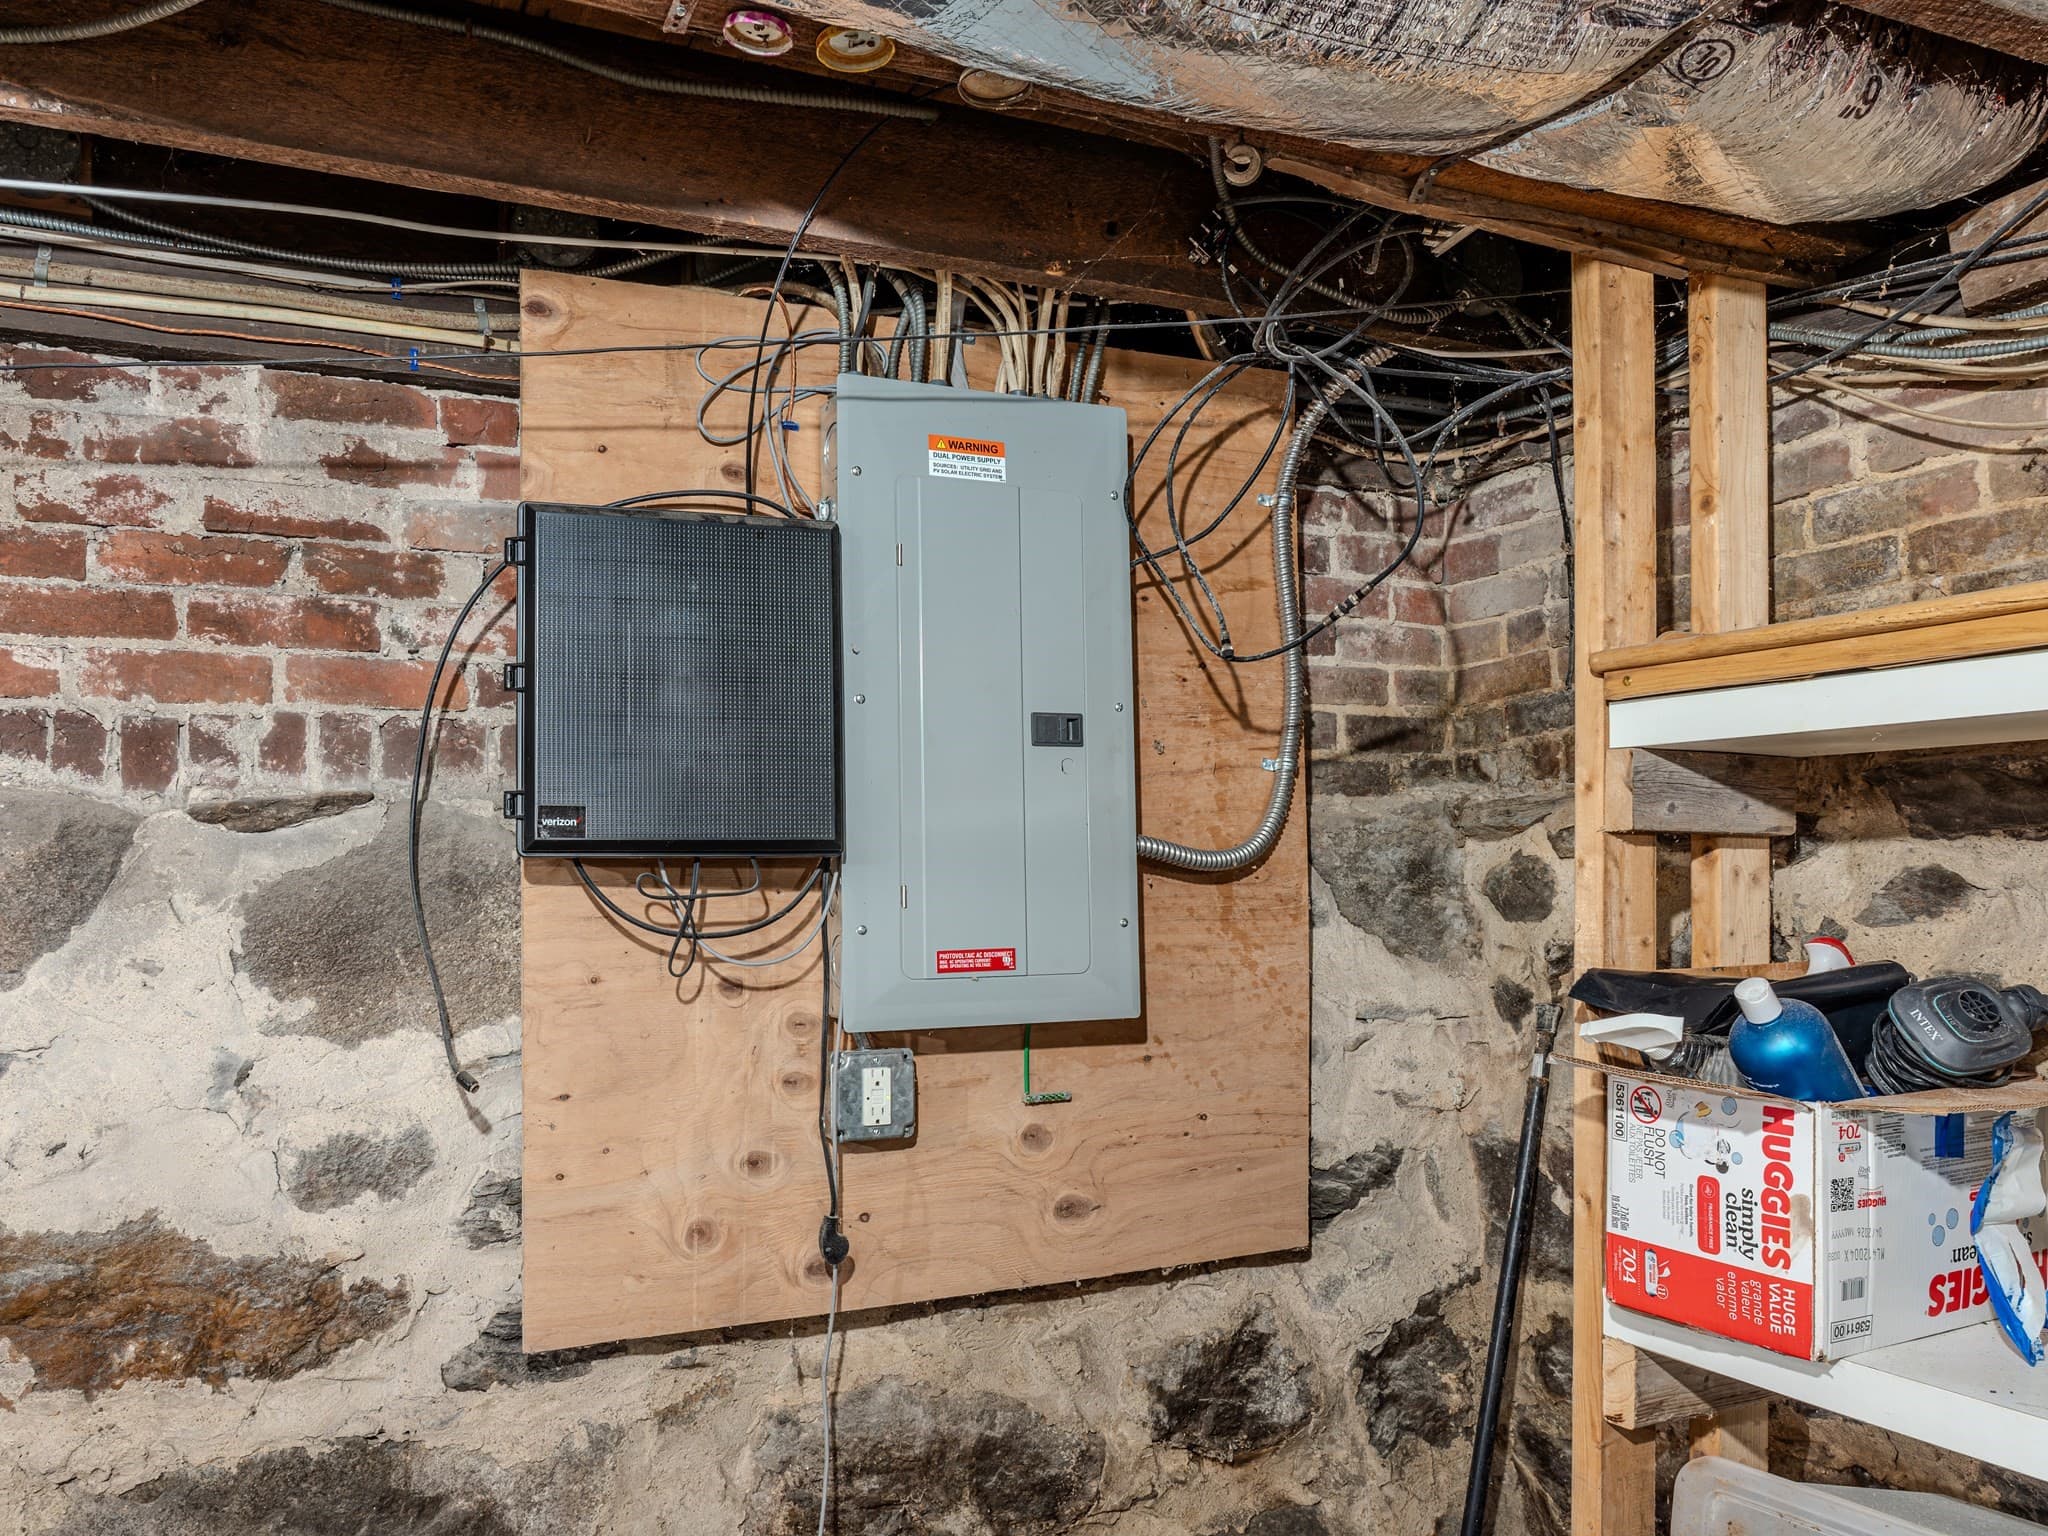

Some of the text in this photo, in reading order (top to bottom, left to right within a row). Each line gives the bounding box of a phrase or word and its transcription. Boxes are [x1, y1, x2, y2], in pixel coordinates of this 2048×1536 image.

[1441, 43, 1496, 62] FLEXIBLE
[1508, 55, 1550, 68] CLASS
[933, 452, 1001, 465] DUAL POWER SUPPLY
[948, 440, 998, 454] WARNING
[960, 464, 978, 472] UTILITY
[542, 817, 577, 826] verizon
[939, 951, 975, 960] PHOTOVOLTAIC
[984, 950, 1013, 958] DISCONNECT
[1909, 1008, 1942, 1042] INTEX
[1636, 1124, 1643, 1136] NE
[1643, 1126, 1654, 1167] FLUSH
[1838, 1123, 1861, 1141] 704
[1628, 1140, 1636, 1183] TOILETTES
[1654, 1128, 1666, 1179] DO NOT
[1759, 1105, 1796, 1272] HUGGIES
[1857, 1196, 1887, 1209] HUGGIES
[1726, 1192, 1741, 1249] clean
[1738, 1188, 1759, 1261] simply
[1622, 1247, 1637, 1284] 704
[1715, 1277, 1728, 1308] valor
[1727, 1271, 1739, 1320] enorme
[1741, 1281, 1752, 1319] valeur
[1750, 1280, 1765, 1325] grande
[1768, 1283, 1782, 1335] VALUE
[1782, 1288, 1796, 1336] HUGE
